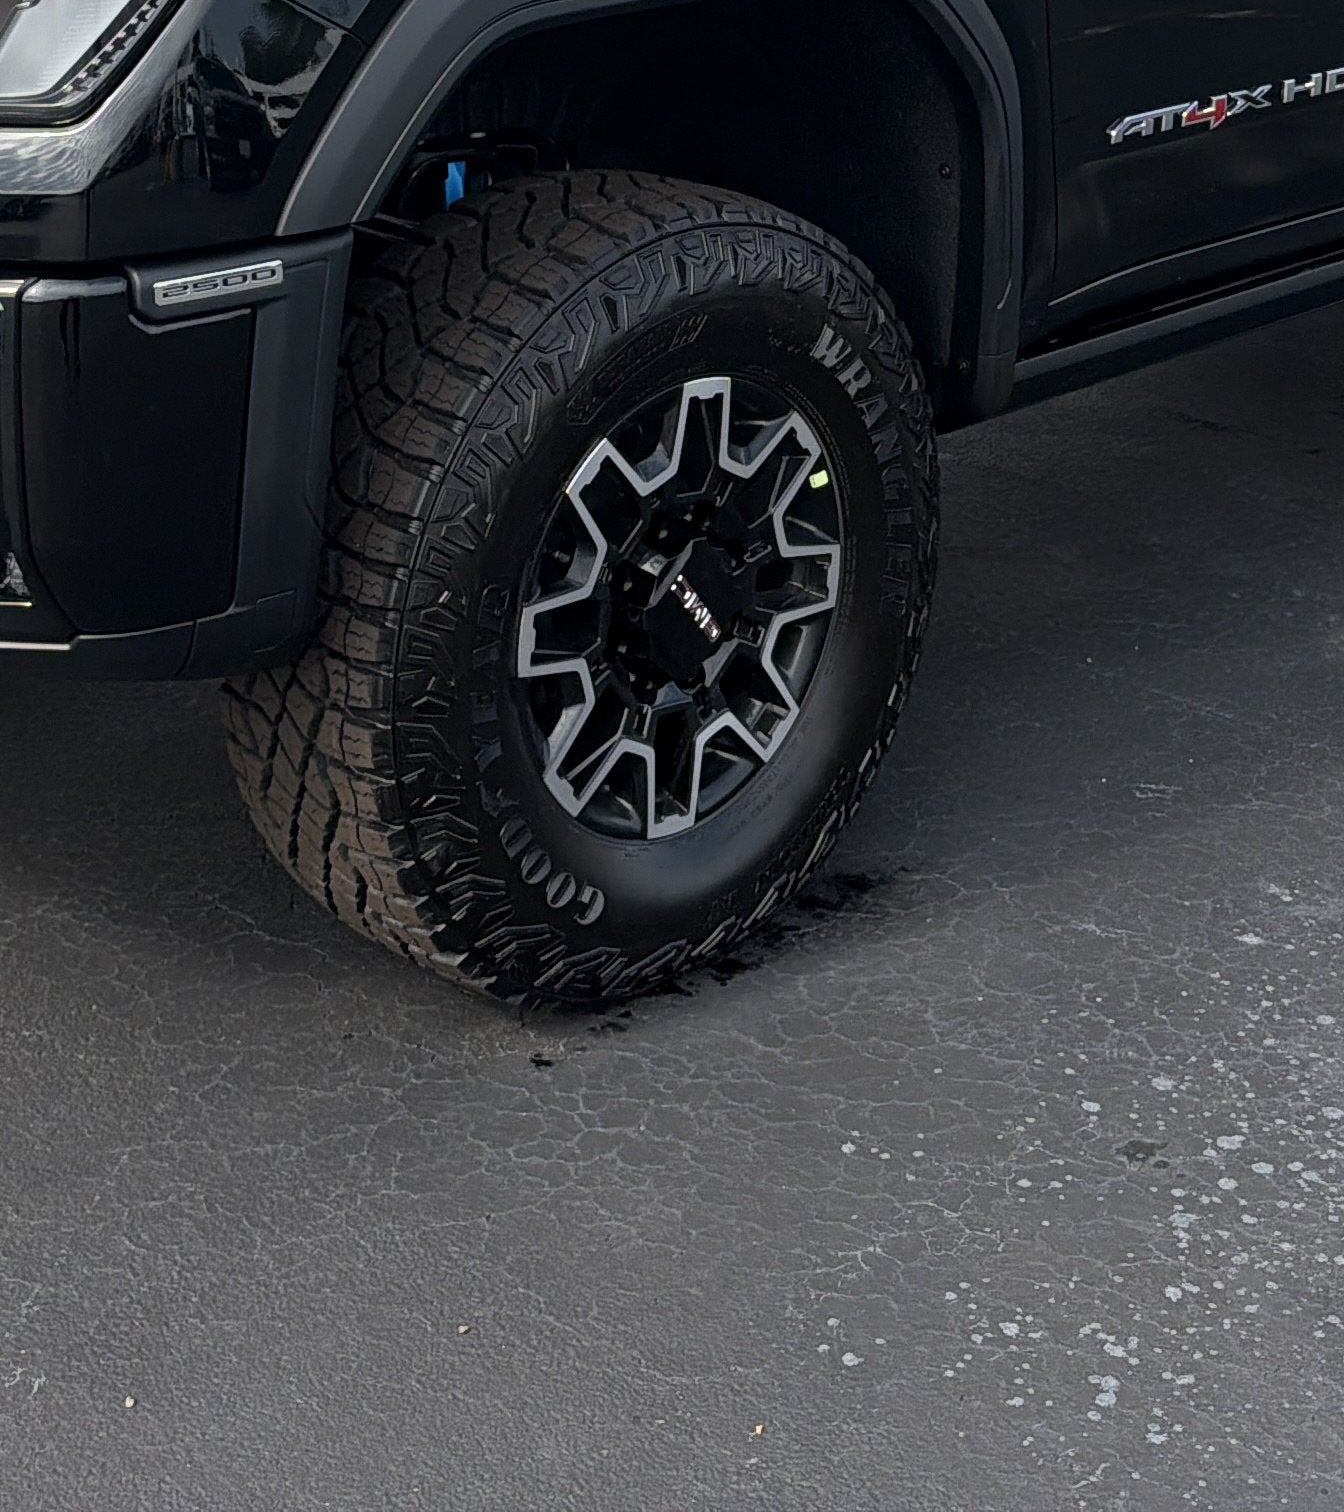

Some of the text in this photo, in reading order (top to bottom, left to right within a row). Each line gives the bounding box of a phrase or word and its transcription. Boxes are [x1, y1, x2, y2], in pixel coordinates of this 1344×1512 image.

[1106, 84, 1273, 145] AT4X
[161, 269, 277, 299] 2500
[809, 323, 913, 616] WRANGLER
[471, 583, 605, 926] GOODYEAR
